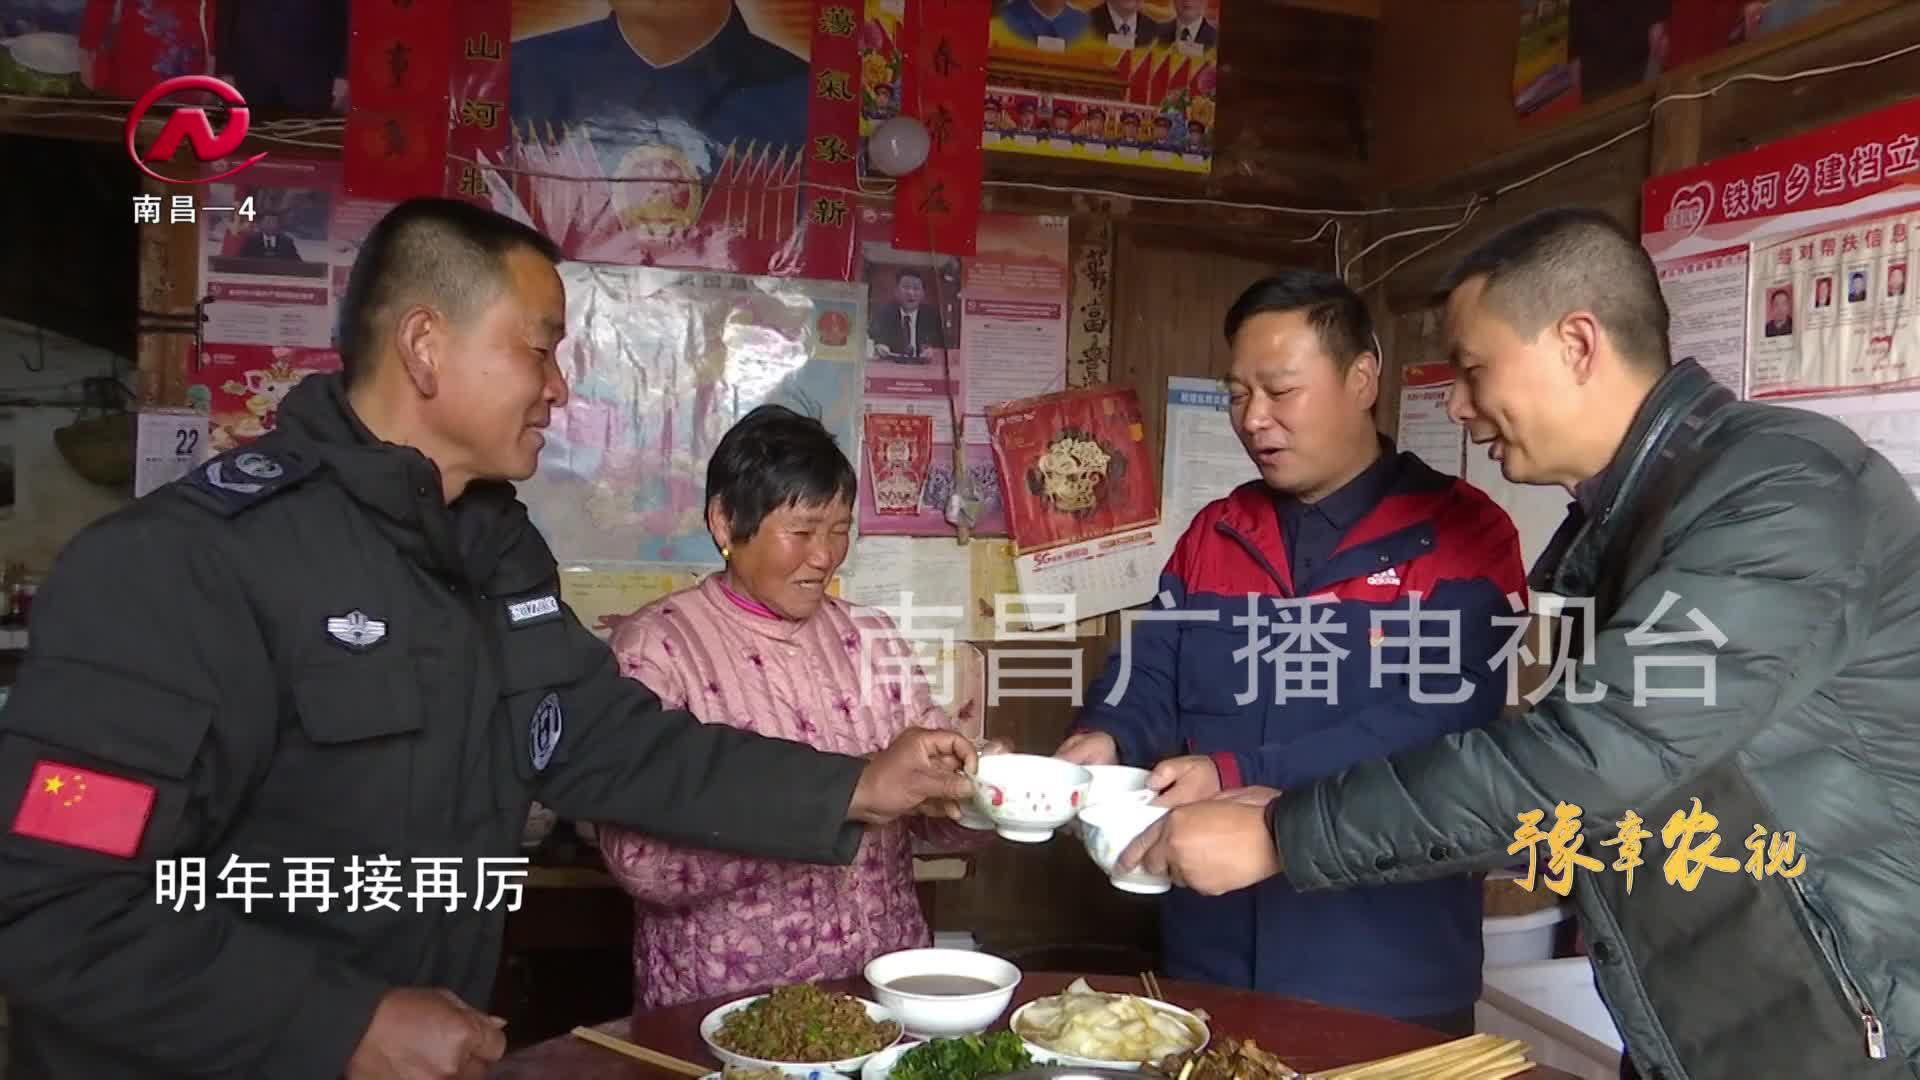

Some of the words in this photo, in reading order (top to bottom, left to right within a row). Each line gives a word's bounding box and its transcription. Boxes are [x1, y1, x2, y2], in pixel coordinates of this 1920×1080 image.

[1723, 134, 1920, 219] 铁河乡建档立
[175, 429, 200, 456] 22
